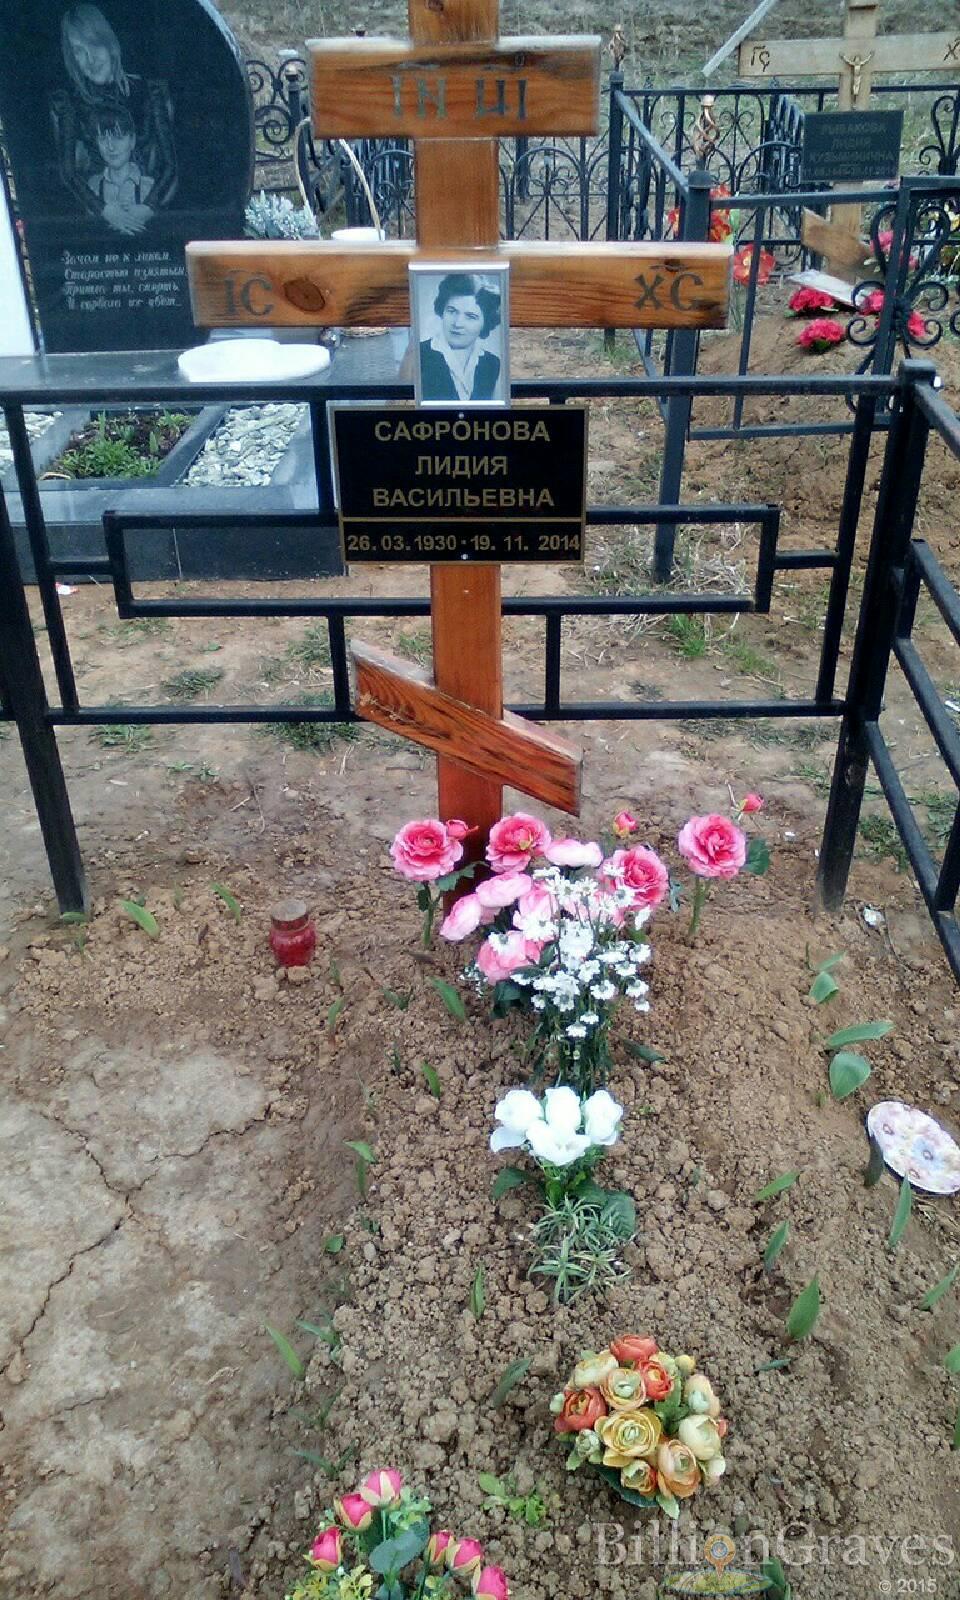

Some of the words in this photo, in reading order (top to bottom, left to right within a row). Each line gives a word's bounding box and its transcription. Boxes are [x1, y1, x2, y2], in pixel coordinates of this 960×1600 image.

[374, 420, 550, 442] САФРОНОВА
[415, 455, 508, 479] ЛИДИЯ
[373, 488, 555, 507] ВАСИЛЬЕВНА
[538, 535, 580, 551] 2014
